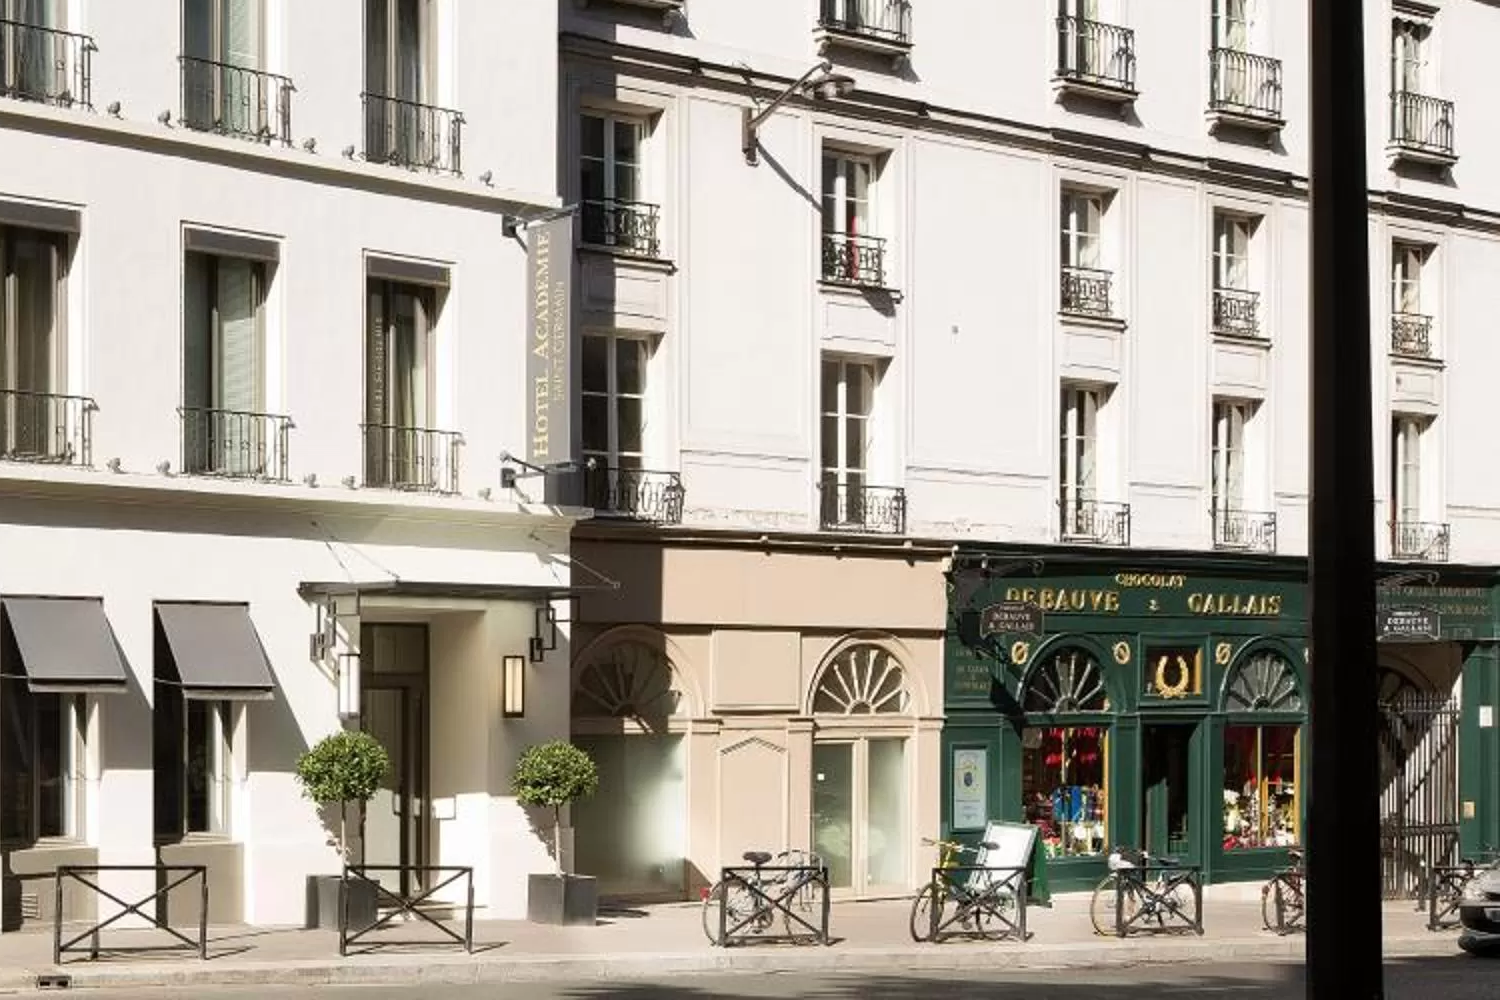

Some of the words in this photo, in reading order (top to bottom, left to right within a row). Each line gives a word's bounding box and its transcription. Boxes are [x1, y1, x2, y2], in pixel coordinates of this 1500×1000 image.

[533, 369, 550, 457] HOTEL
[1114, 573, 1187, 588] CHOCOLAT
[1187, 592, 1282, 616] GALLAIS
